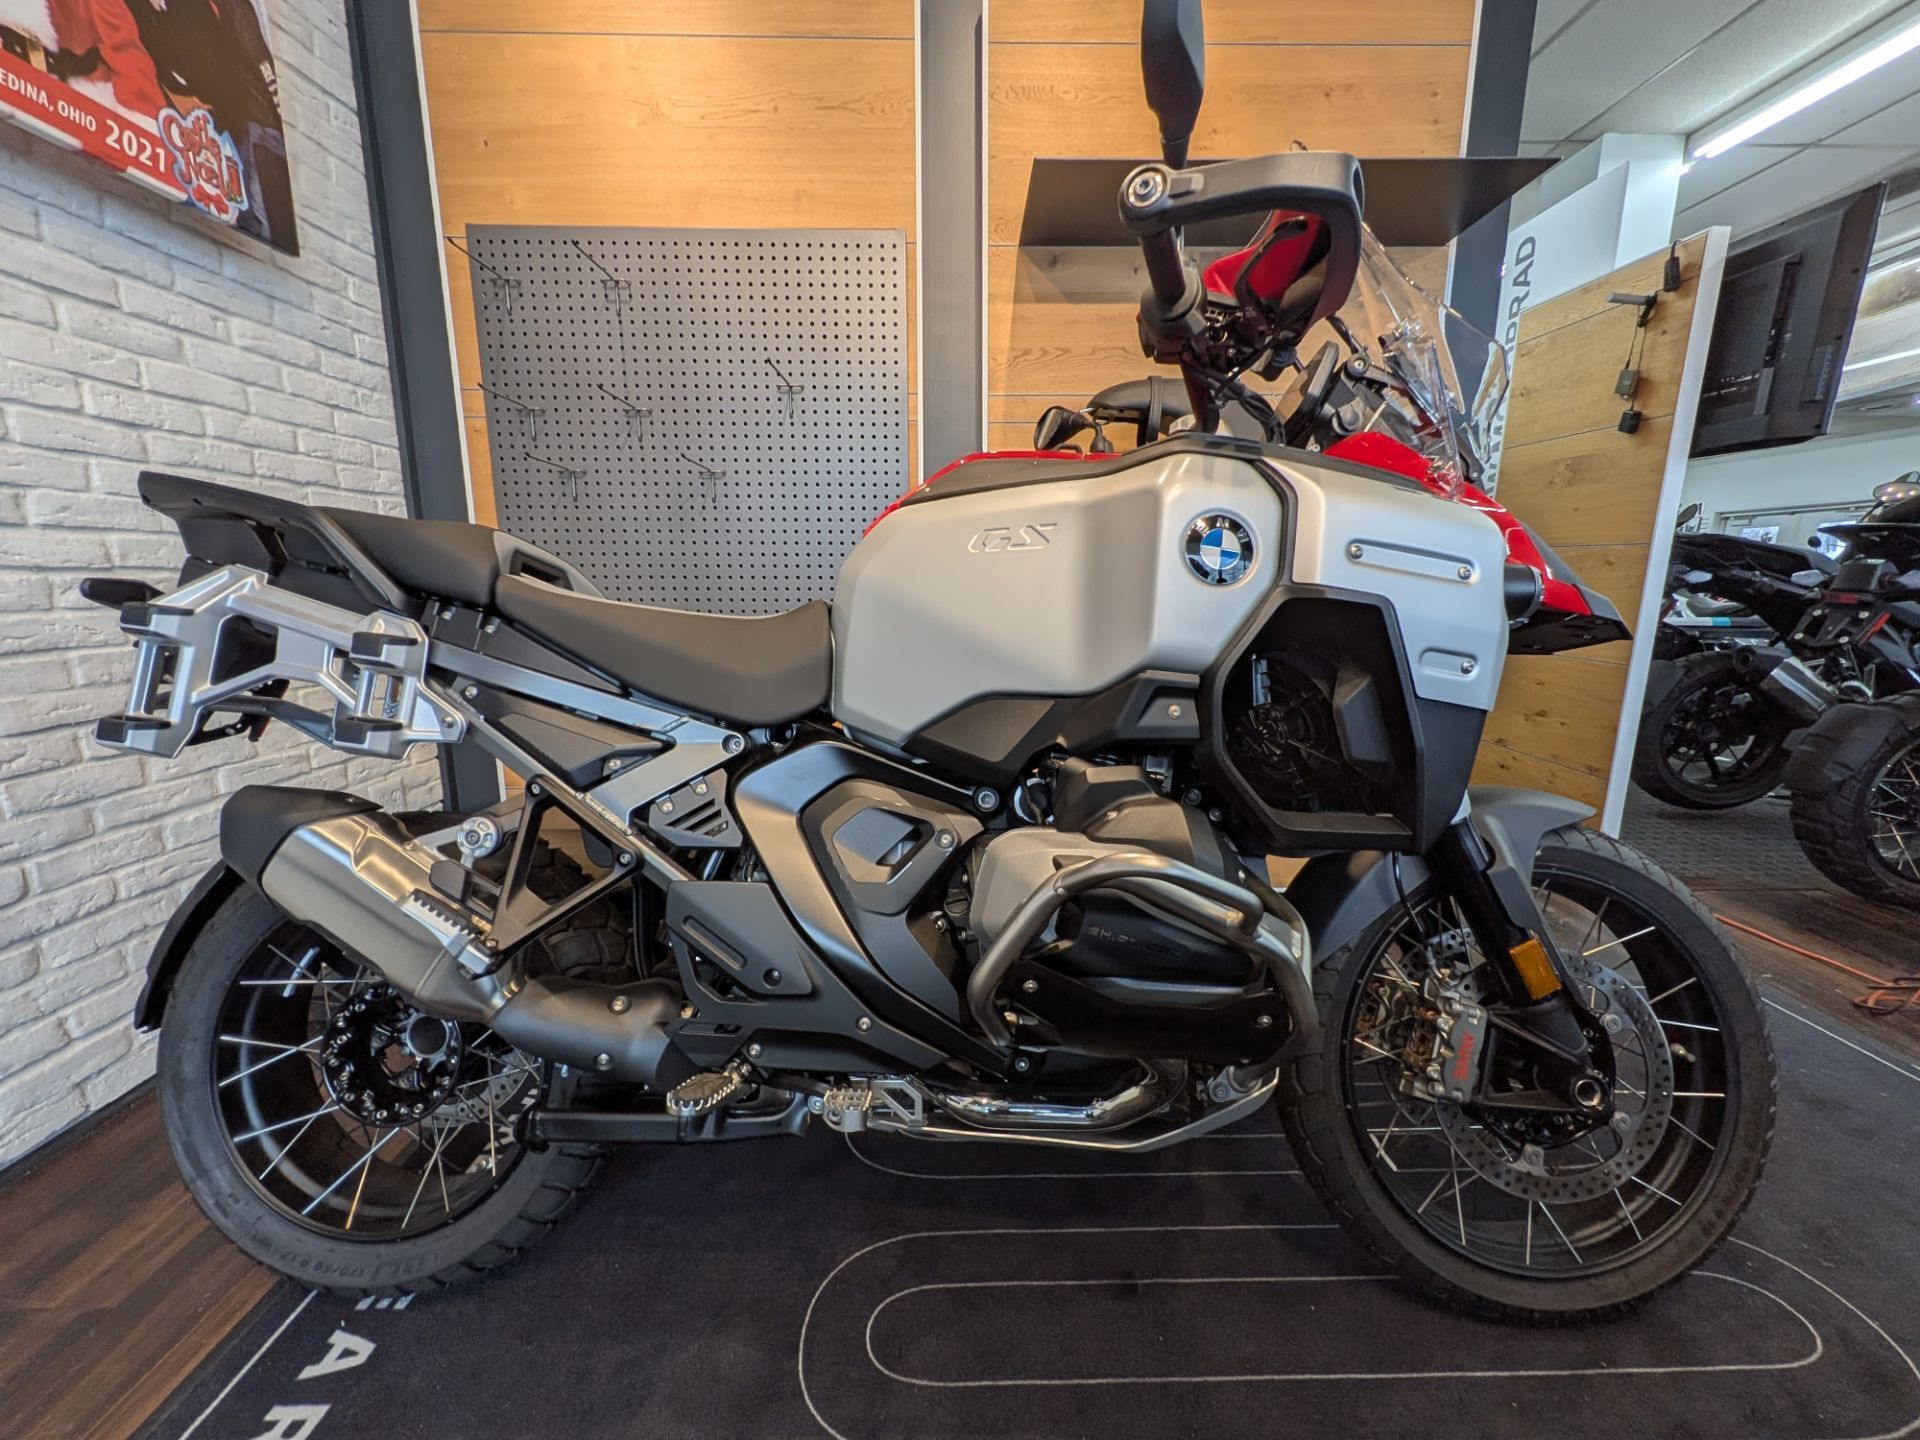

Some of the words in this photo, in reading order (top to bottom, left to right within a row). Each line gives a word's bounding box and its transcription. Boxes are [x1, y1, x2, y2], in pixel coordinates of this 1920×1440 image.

[58, 100, 97, 132] OHIO
[105, 119, 165, 173] 2021
[968, 522, 1058, 553] GS
[1194, 516, 1250, 543] BMW
